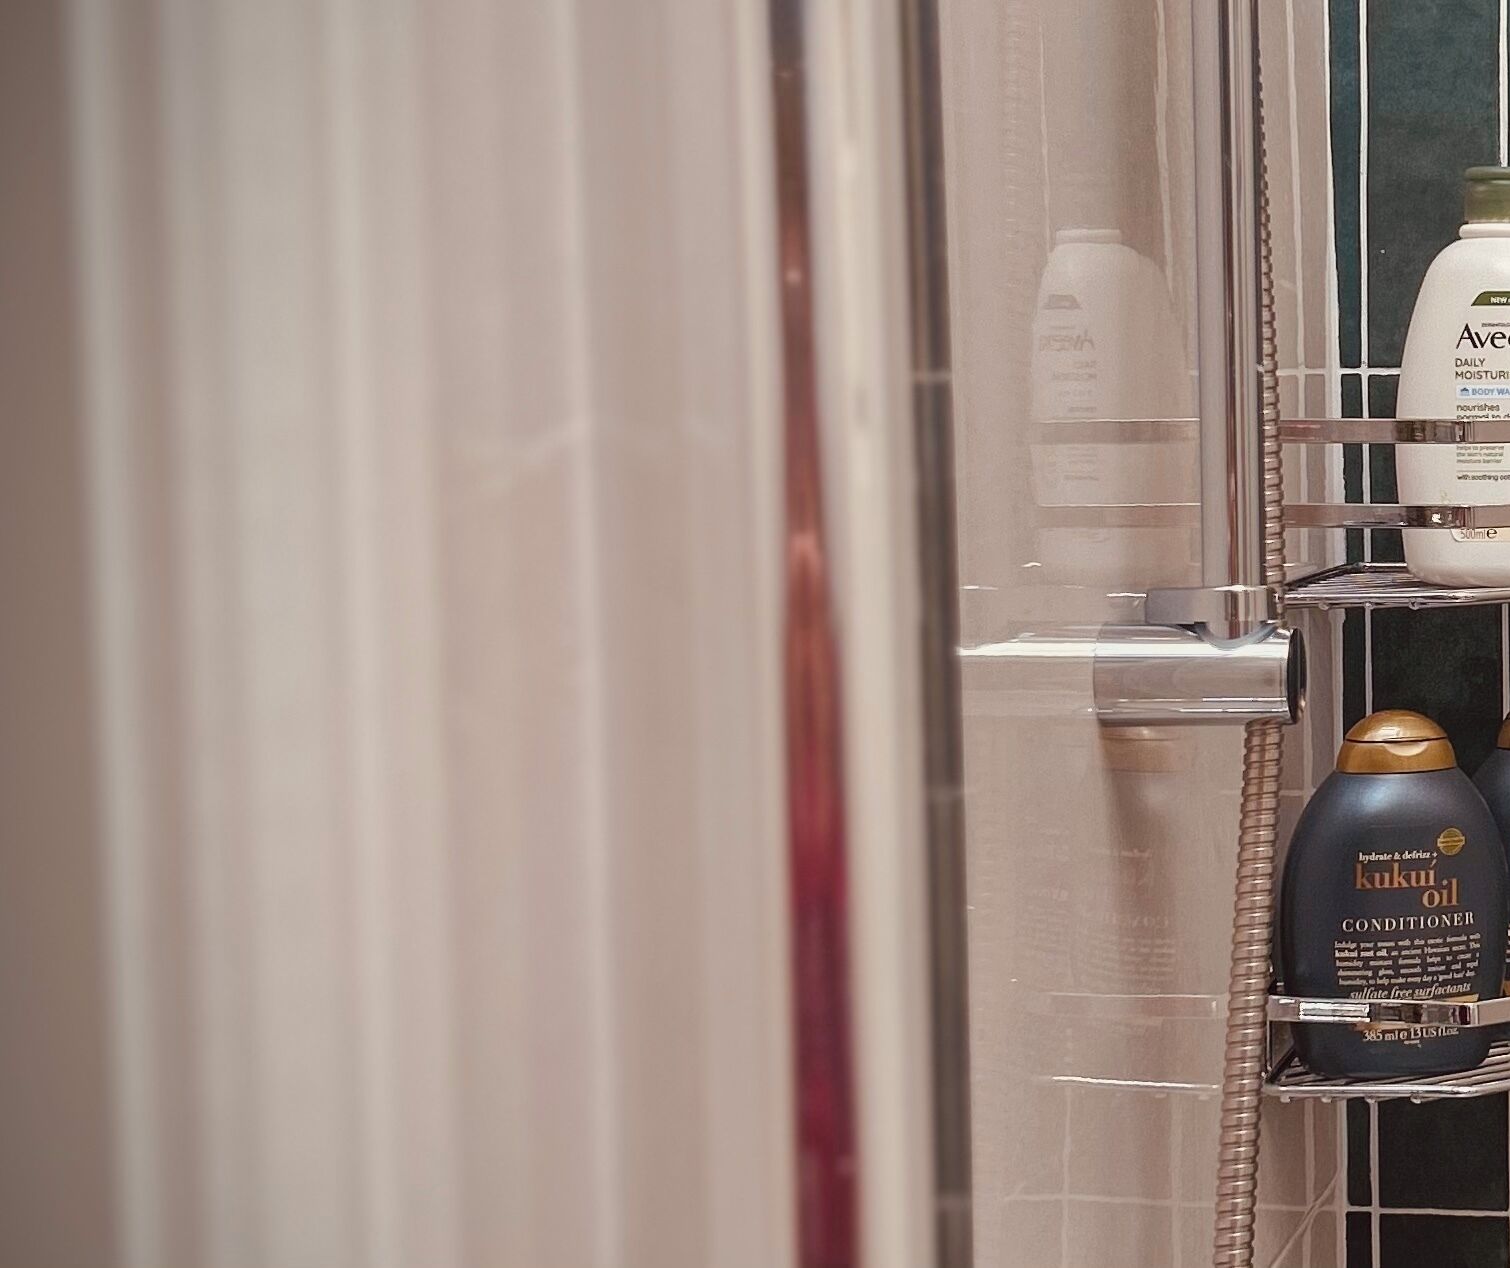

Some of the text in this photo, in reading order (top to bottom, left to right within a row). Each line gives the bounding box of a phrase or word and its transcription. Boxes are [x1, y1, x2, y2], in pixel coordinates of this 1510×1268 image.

[1455, 358, 1485, 367] DAILY
[1471, 388, 1494, 396] BODY
[1456, 403, 1500, 411] nourishes
[1359, 852, 1392, 863] hydrate
[1394, 851, 1401, 860] &
[1402, 850, 1431, 860] defrizz
[1422, 878, 1459, 908] oil
[1342, 911, 1475, 932] CONDITIONER
[1350, 982, 1471, 1000] sulfate free surfactants
[1363, 1030, 1383, 1041] 385
[1384, 1029, 1398, 1040] ml
[1410, 1027, 1422, 1039] 13
[1423, 1026, 1436, 1038] US
